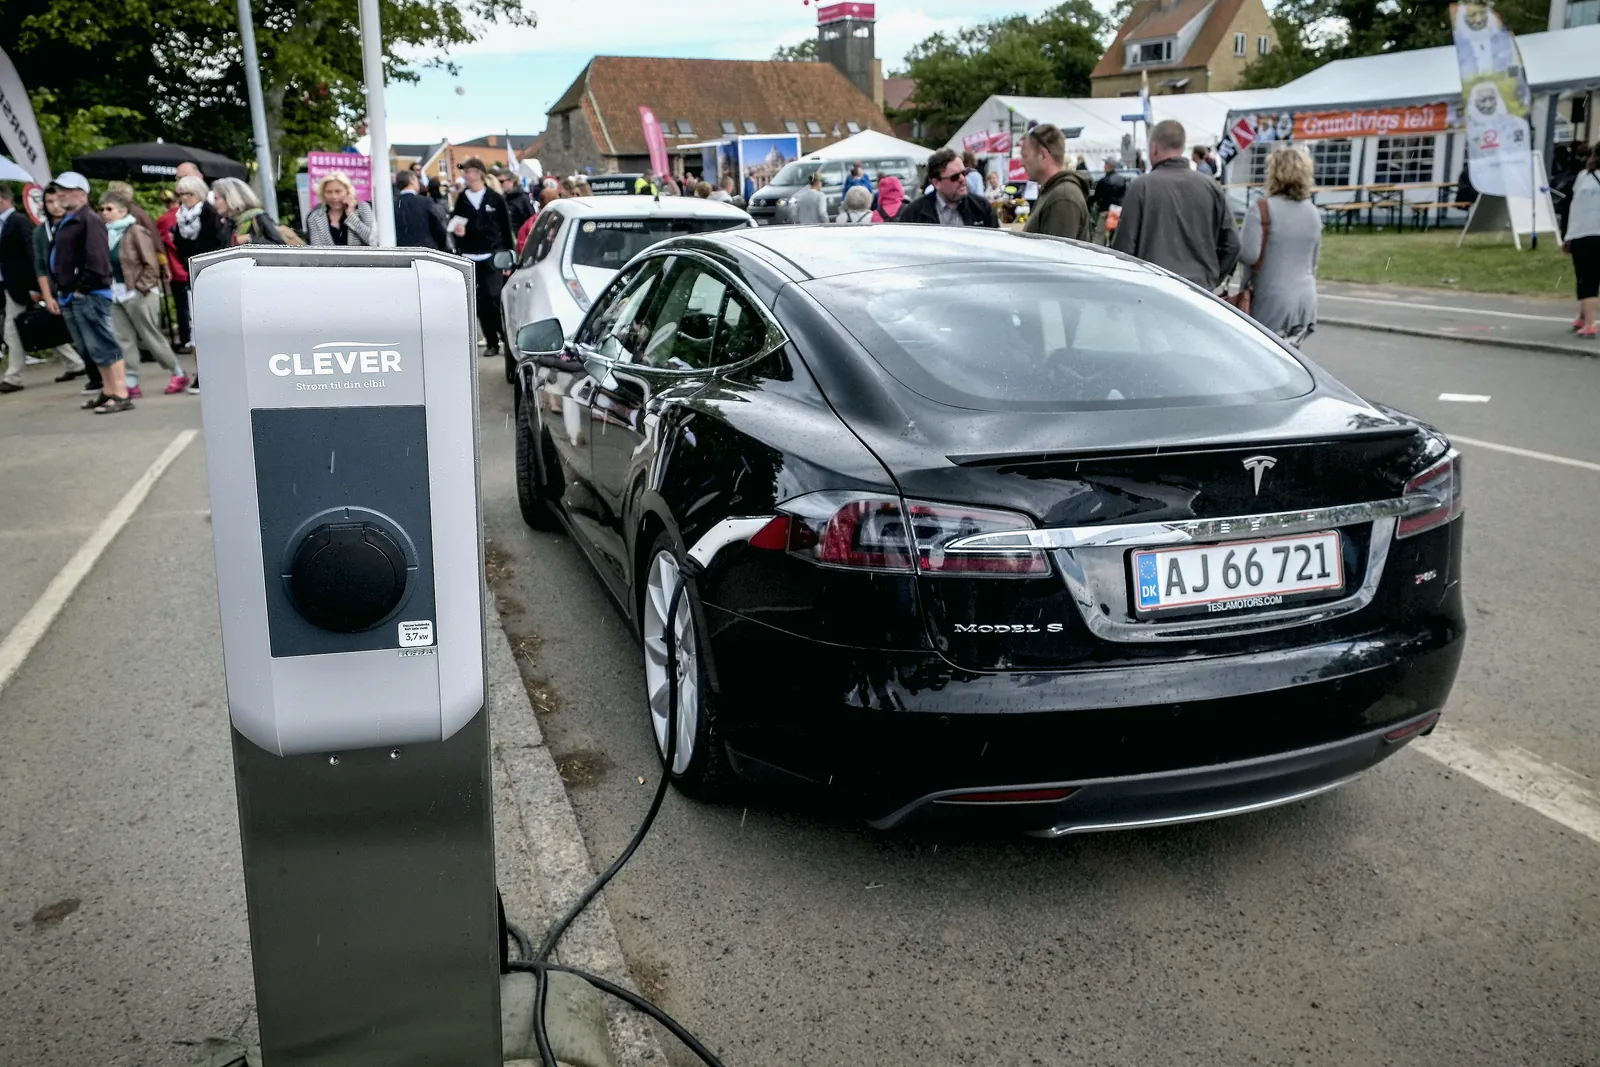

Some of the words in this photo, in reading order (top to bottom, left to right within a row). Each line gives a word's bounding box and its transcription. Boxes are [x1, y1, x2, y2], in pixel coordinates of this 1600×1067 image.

[268, 350, 403, 377] CLEVER
[296, 382, 329, 391] Strøm
[330, 381, 341, 390] til
[343, 380, 362, 389] din
[363, 379, 386, 389] elbil
[1165, 554, 1210, 596] AJ
[1222, 547, 1264, 589] 66
[1272, 542, 1331, 583] 721
[1142, 585, 1158, 598] DK
[1207, 596, 1283, 613] TESLAMOTORS.COM
[954, 623, 1041, 633] MODEL
[1046, 623, 1064, 633] S
[405, 633, 418, 641] 3,7
